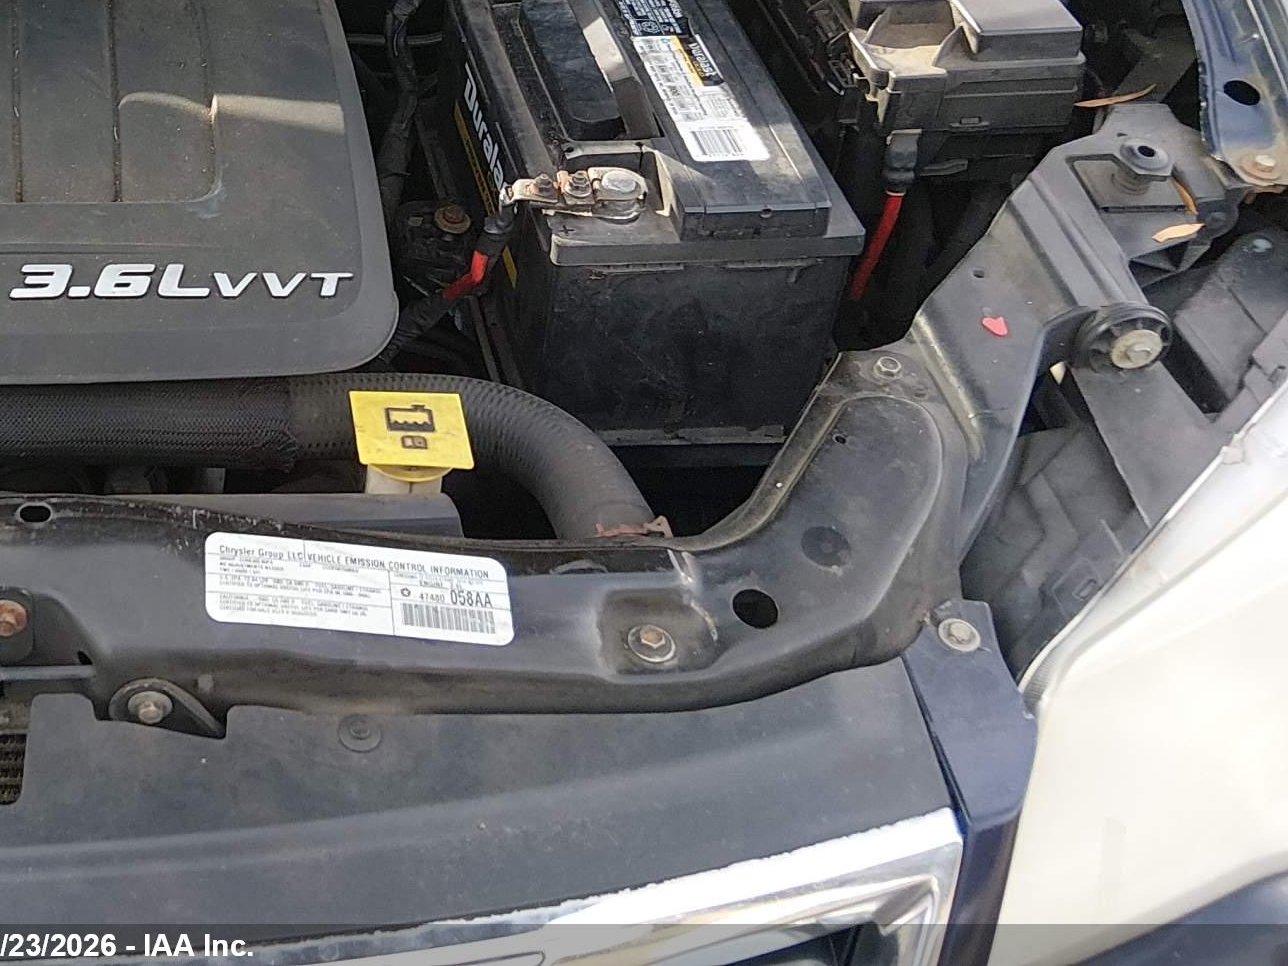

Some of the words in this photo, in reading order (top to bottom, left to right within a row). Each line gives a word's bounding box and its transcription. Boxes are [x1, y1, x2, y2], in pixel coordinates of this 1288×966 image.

[9, 263, 210, 299] 3.6L
[212, 272, 354, 297] VVT
[220, 545, 256, 558] Chrysler
[258, 548, 284, 560] Group
[287, 551, 303, 560] LLC
[306, 552, 342, 564] VEHICLE
[345, 557, 386, 569] EMISSION
[388, 561, 426, 572] CONTROL
[430, 565, 489, 579] INFORMATION
[450, 589, 492, 608] 058AA
